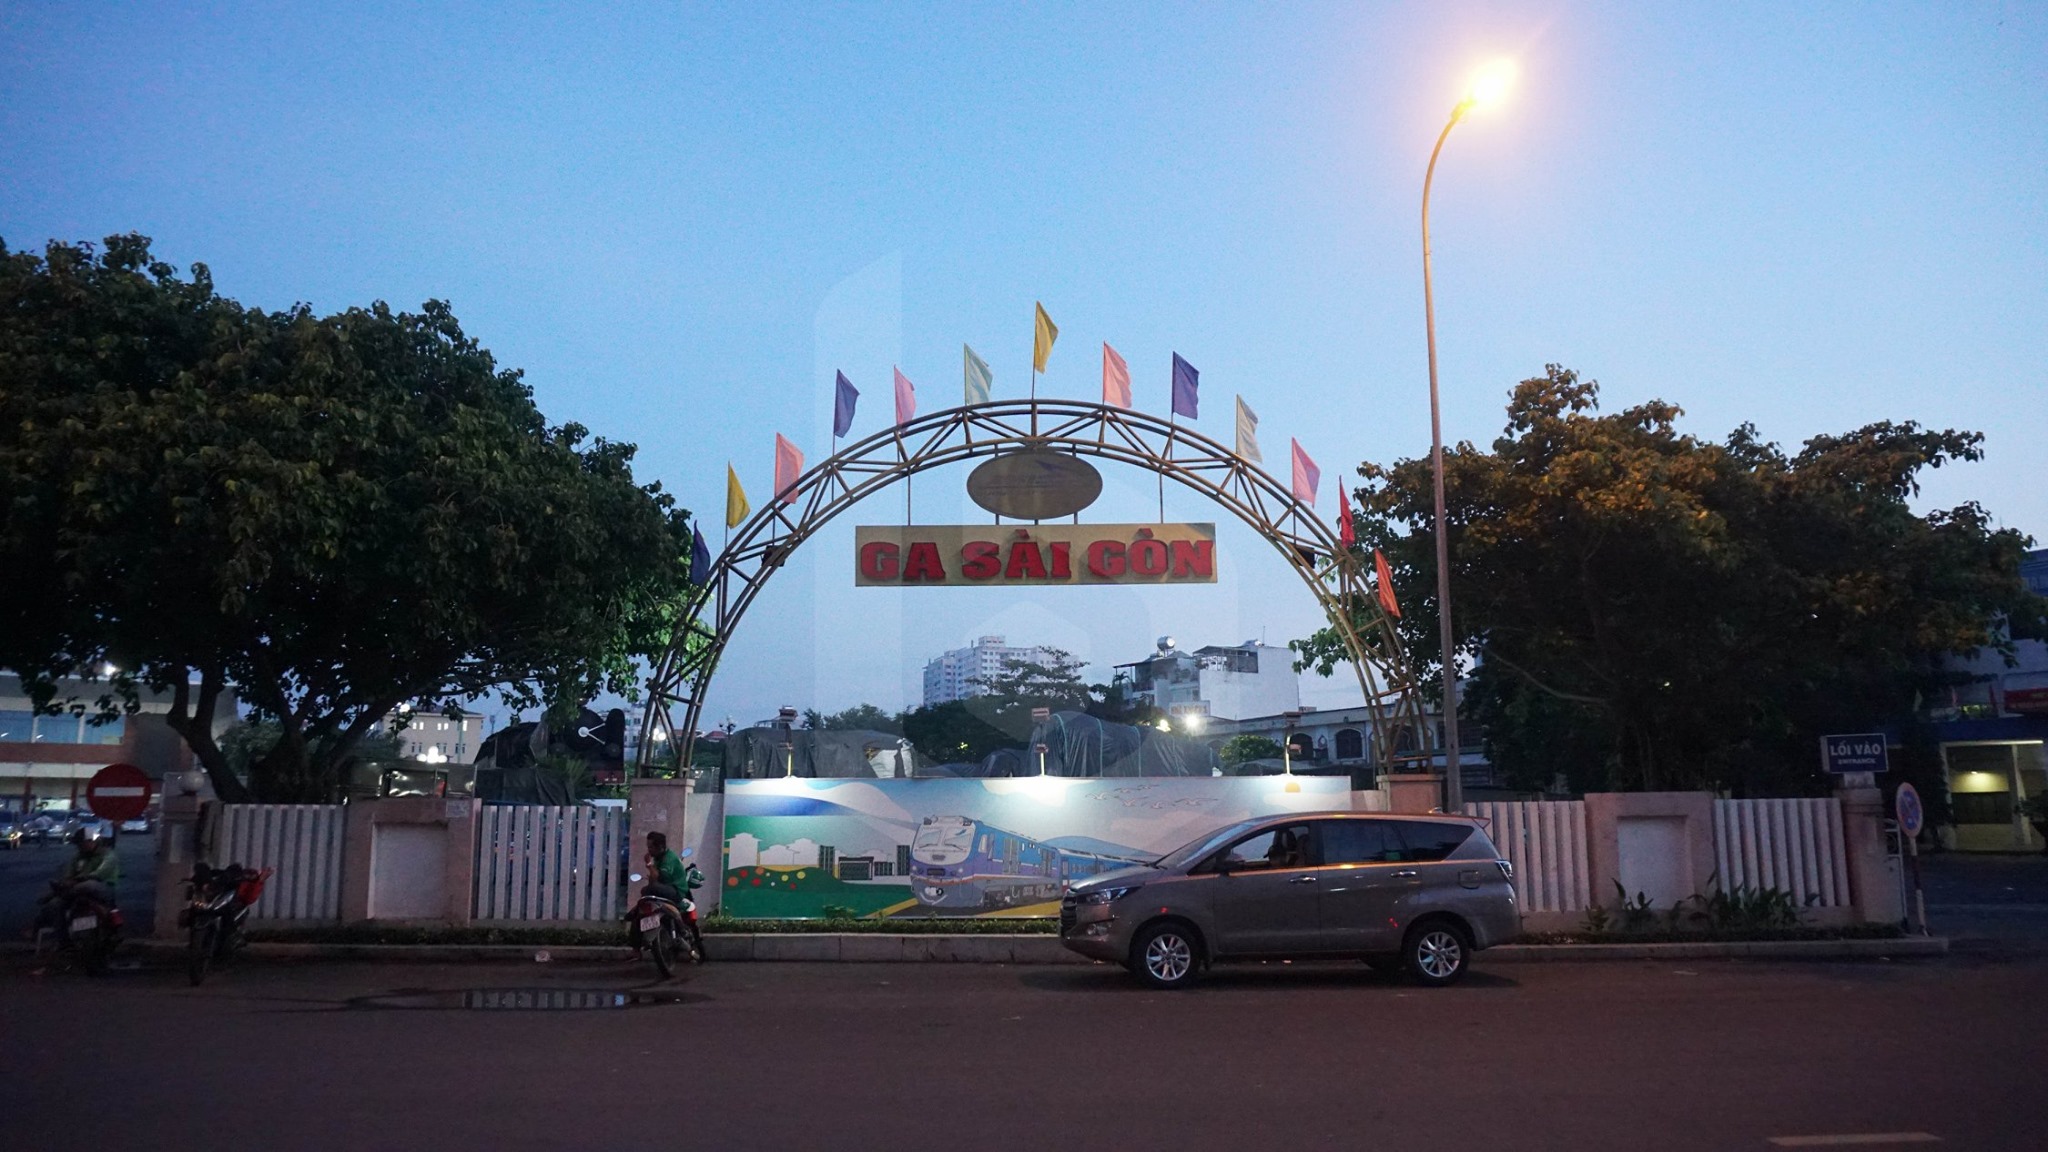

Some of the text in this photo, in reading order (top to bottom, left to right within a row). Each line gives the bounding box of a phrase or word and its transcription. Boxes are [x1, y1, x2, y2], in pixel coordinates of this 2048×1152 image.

[860, 528, 1214, 579] GA SÀI GÒN
[1830, 740, 1881, 756] LỐI VÀO
